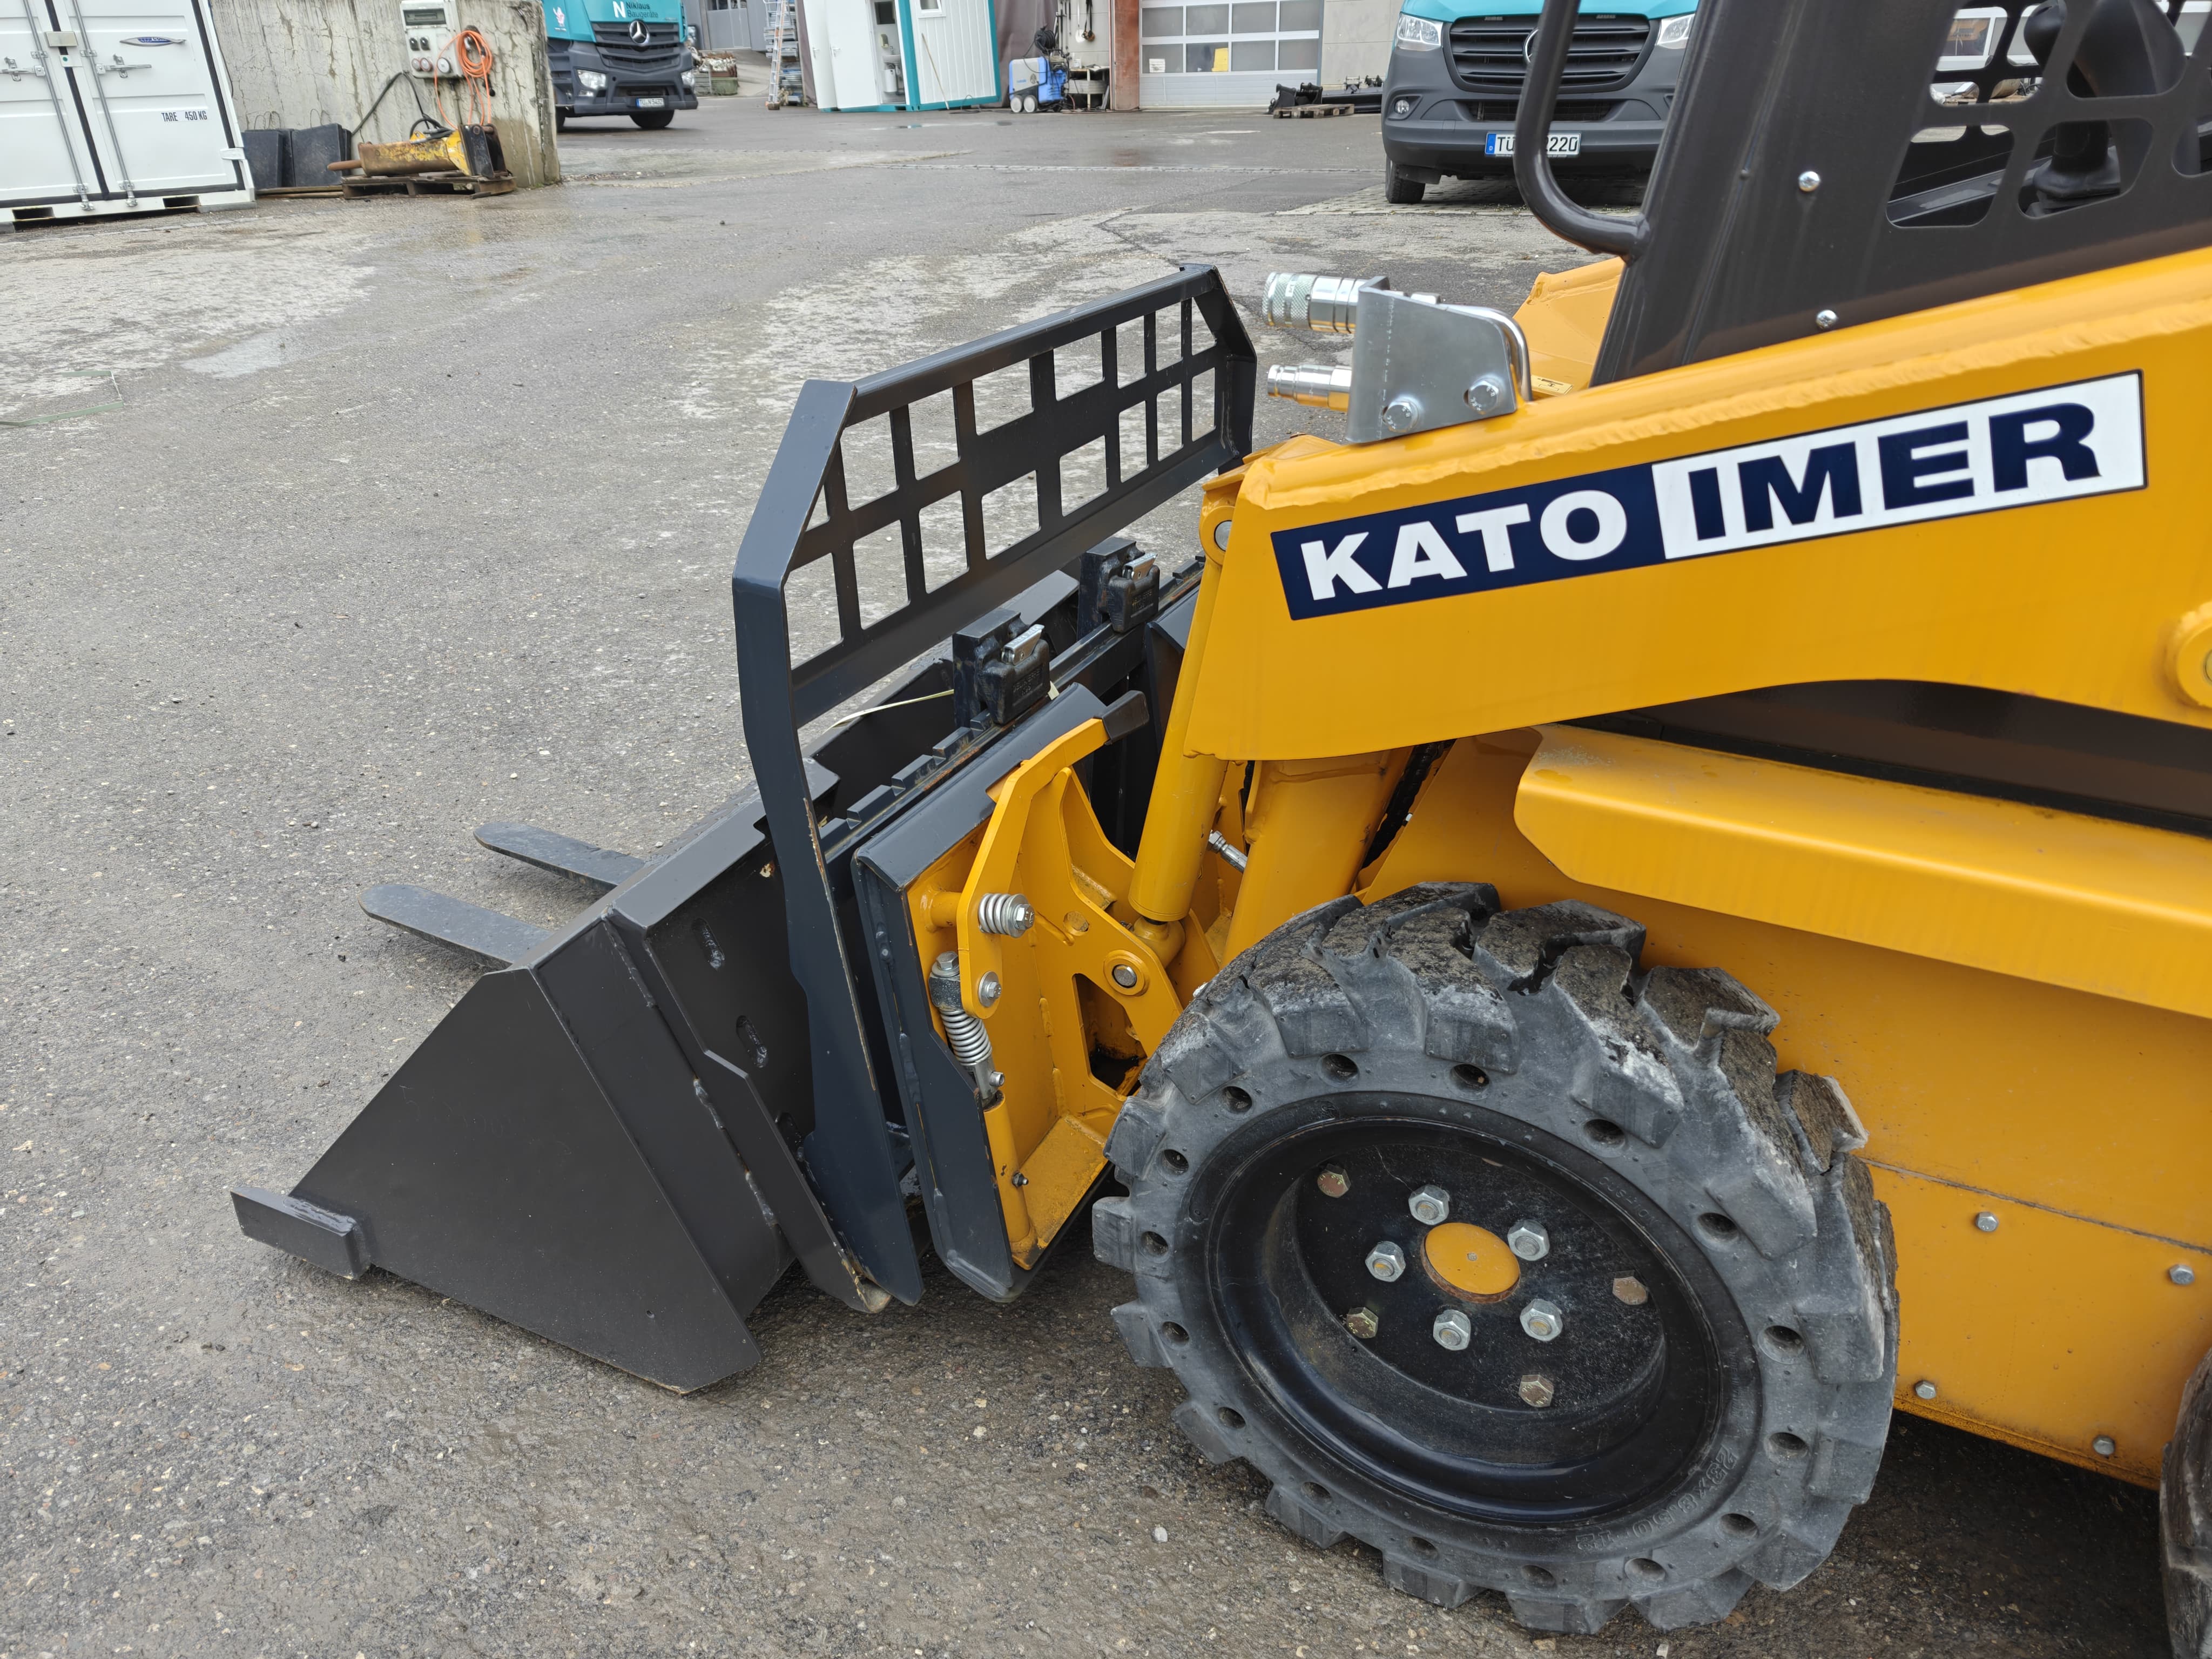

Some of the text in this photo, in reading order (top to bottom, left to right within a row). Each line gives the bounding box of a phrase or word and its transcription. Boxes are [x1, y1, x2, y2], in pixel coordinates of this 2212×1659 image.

[612, 1, 626, 18] N
[626, 1, 650, 9] Niklaus
[627, 10, 658, 18] Baugeräte
[161, 110, 207, 122] TARE 450 KG
[1300, 402, 2102, 601] KATO IMER
